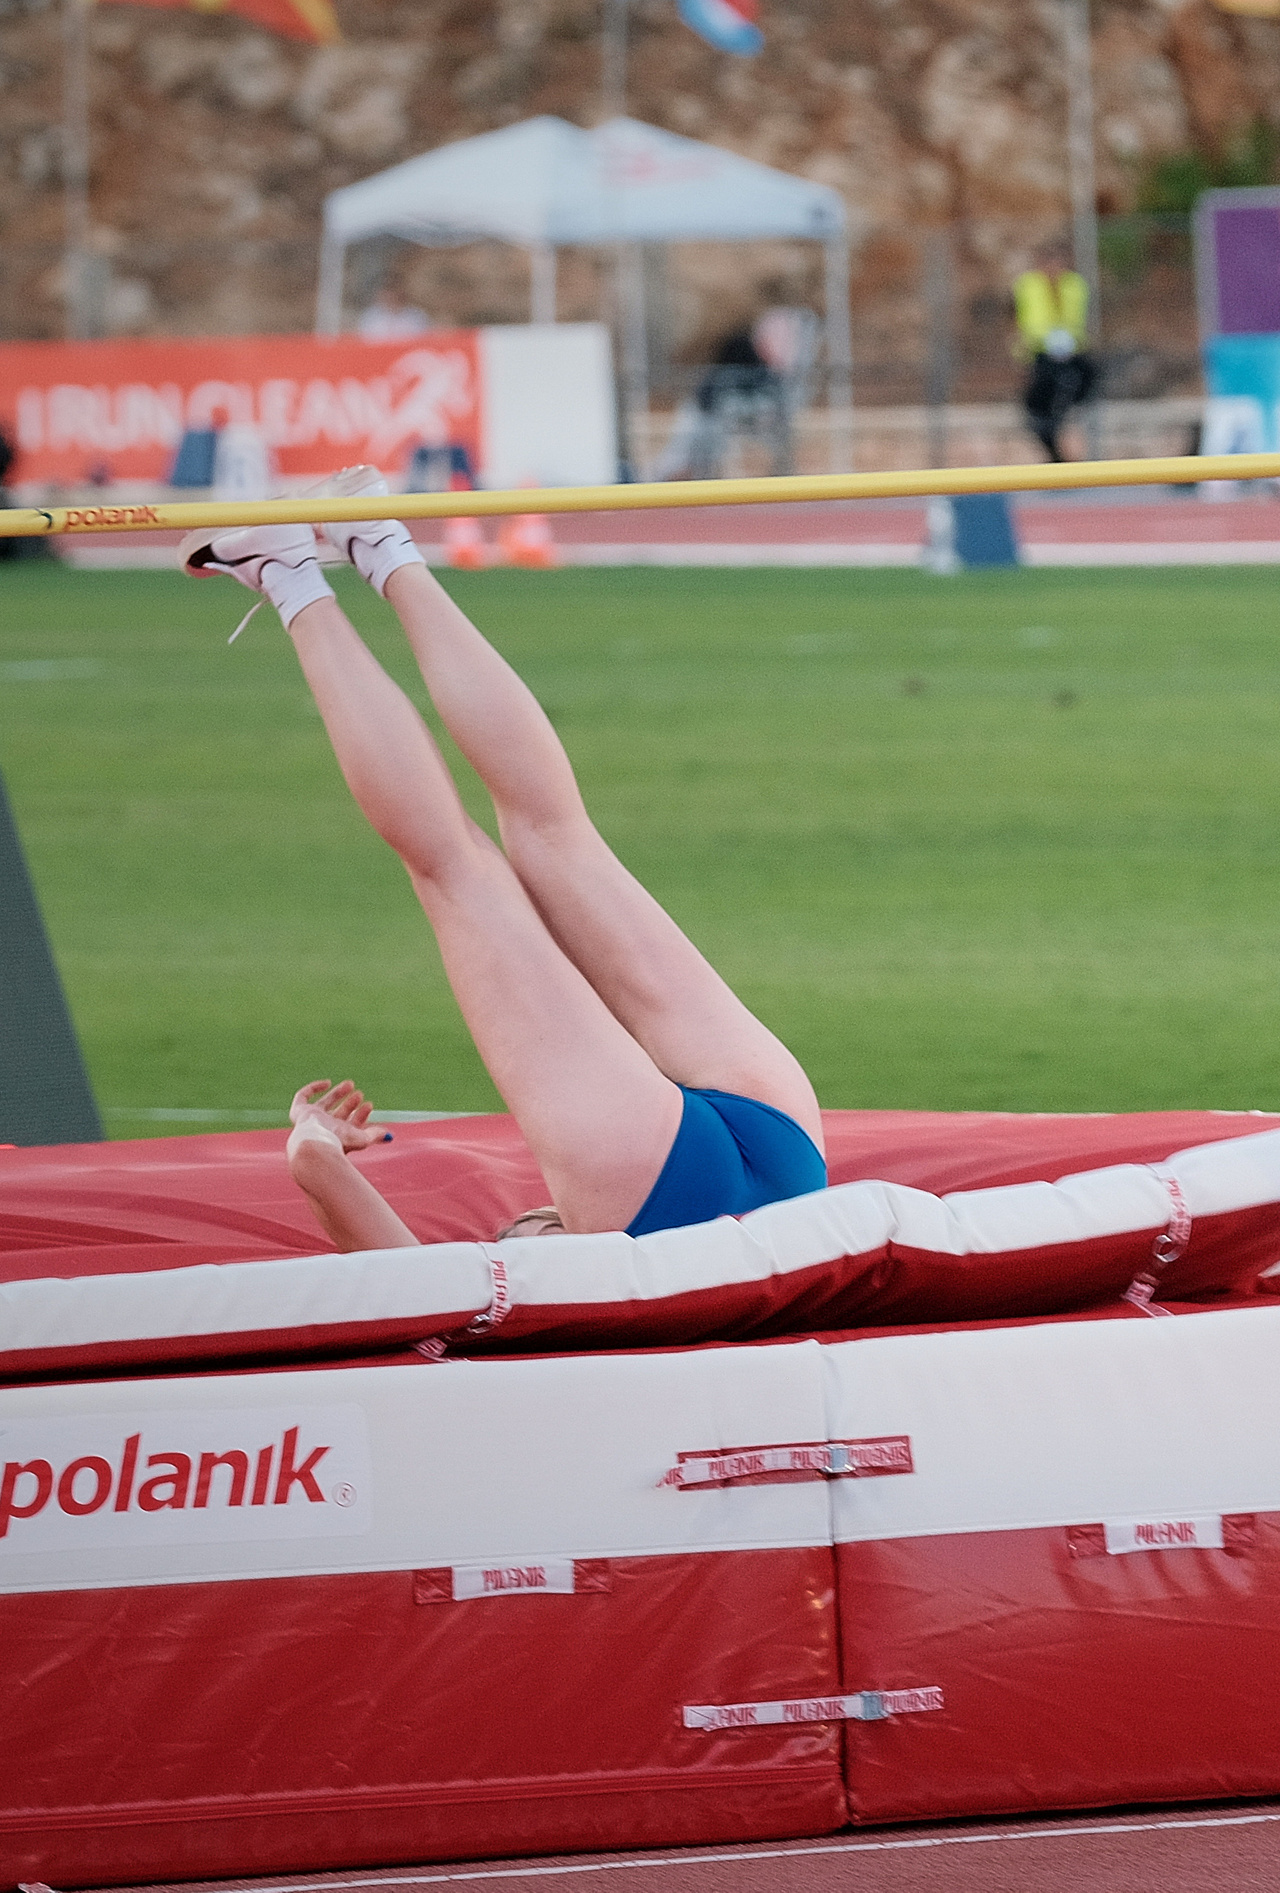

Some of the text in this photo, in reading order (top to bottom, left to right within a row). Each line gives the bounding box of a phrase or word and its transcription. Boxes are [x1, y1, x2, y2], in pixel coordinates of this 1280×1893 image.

[47, 382, 183, 451] RUN
[63, 506, 158, 532] polanik
[0, 1424, 332, 1539] polanik
